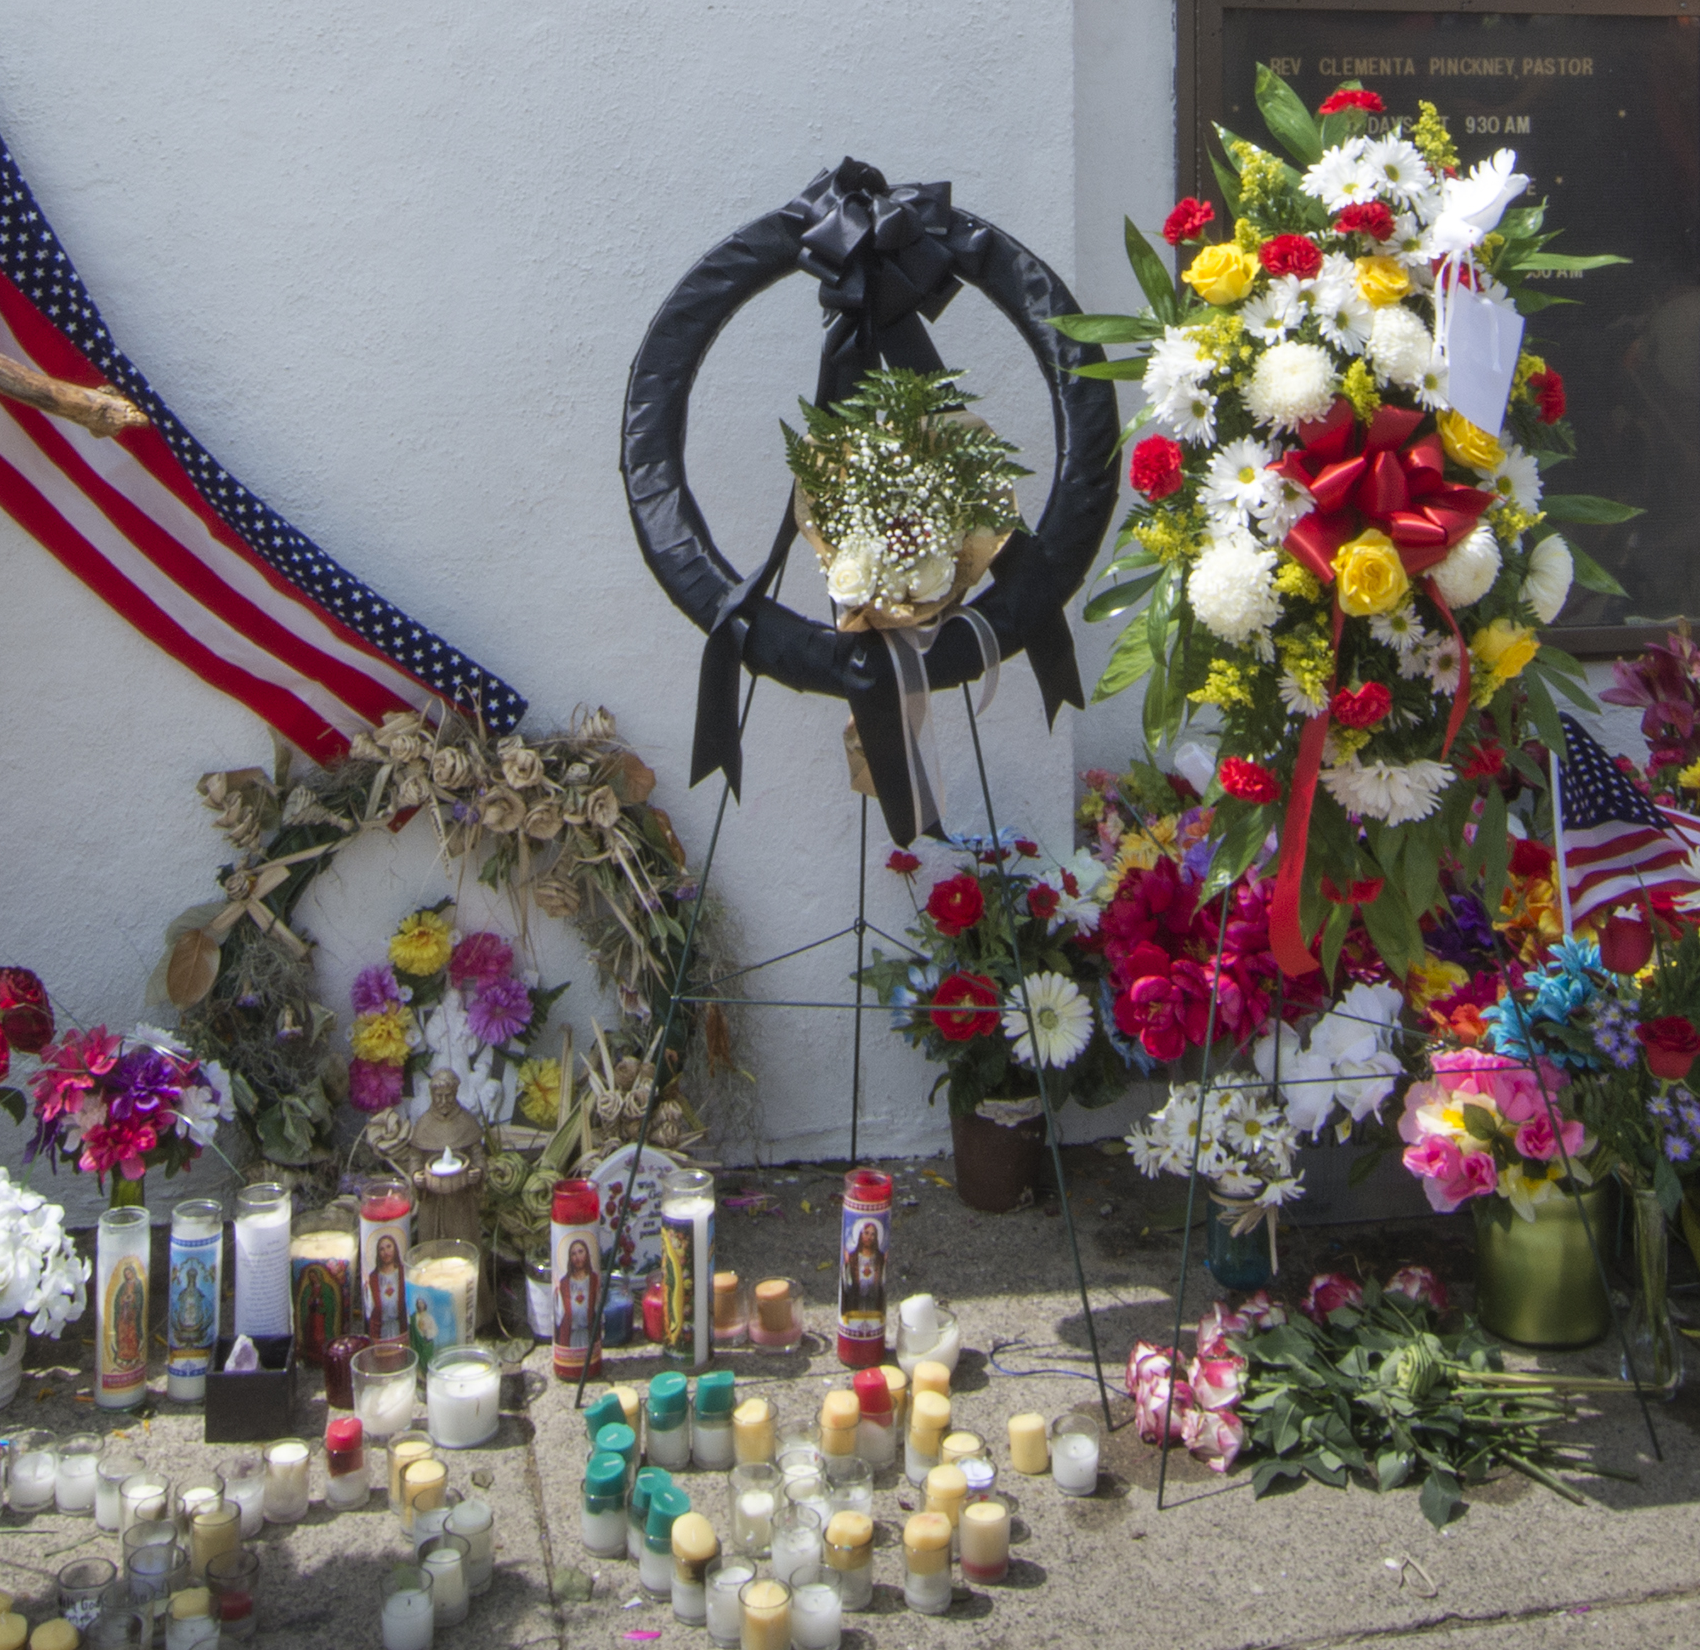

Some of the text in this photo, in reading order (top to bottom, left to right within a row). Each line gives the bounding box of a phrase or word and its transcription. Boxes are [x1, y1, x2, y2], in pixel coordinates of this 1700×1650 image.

[1270, 57, 1301, 76] REV
[1318, 57, 1415, 77] CLEMENTA
[1522, 58, 1594, 77] PASTOR
[1465, 116, 1500, 134] 930
[1504, 116, 1531, 135] AM
